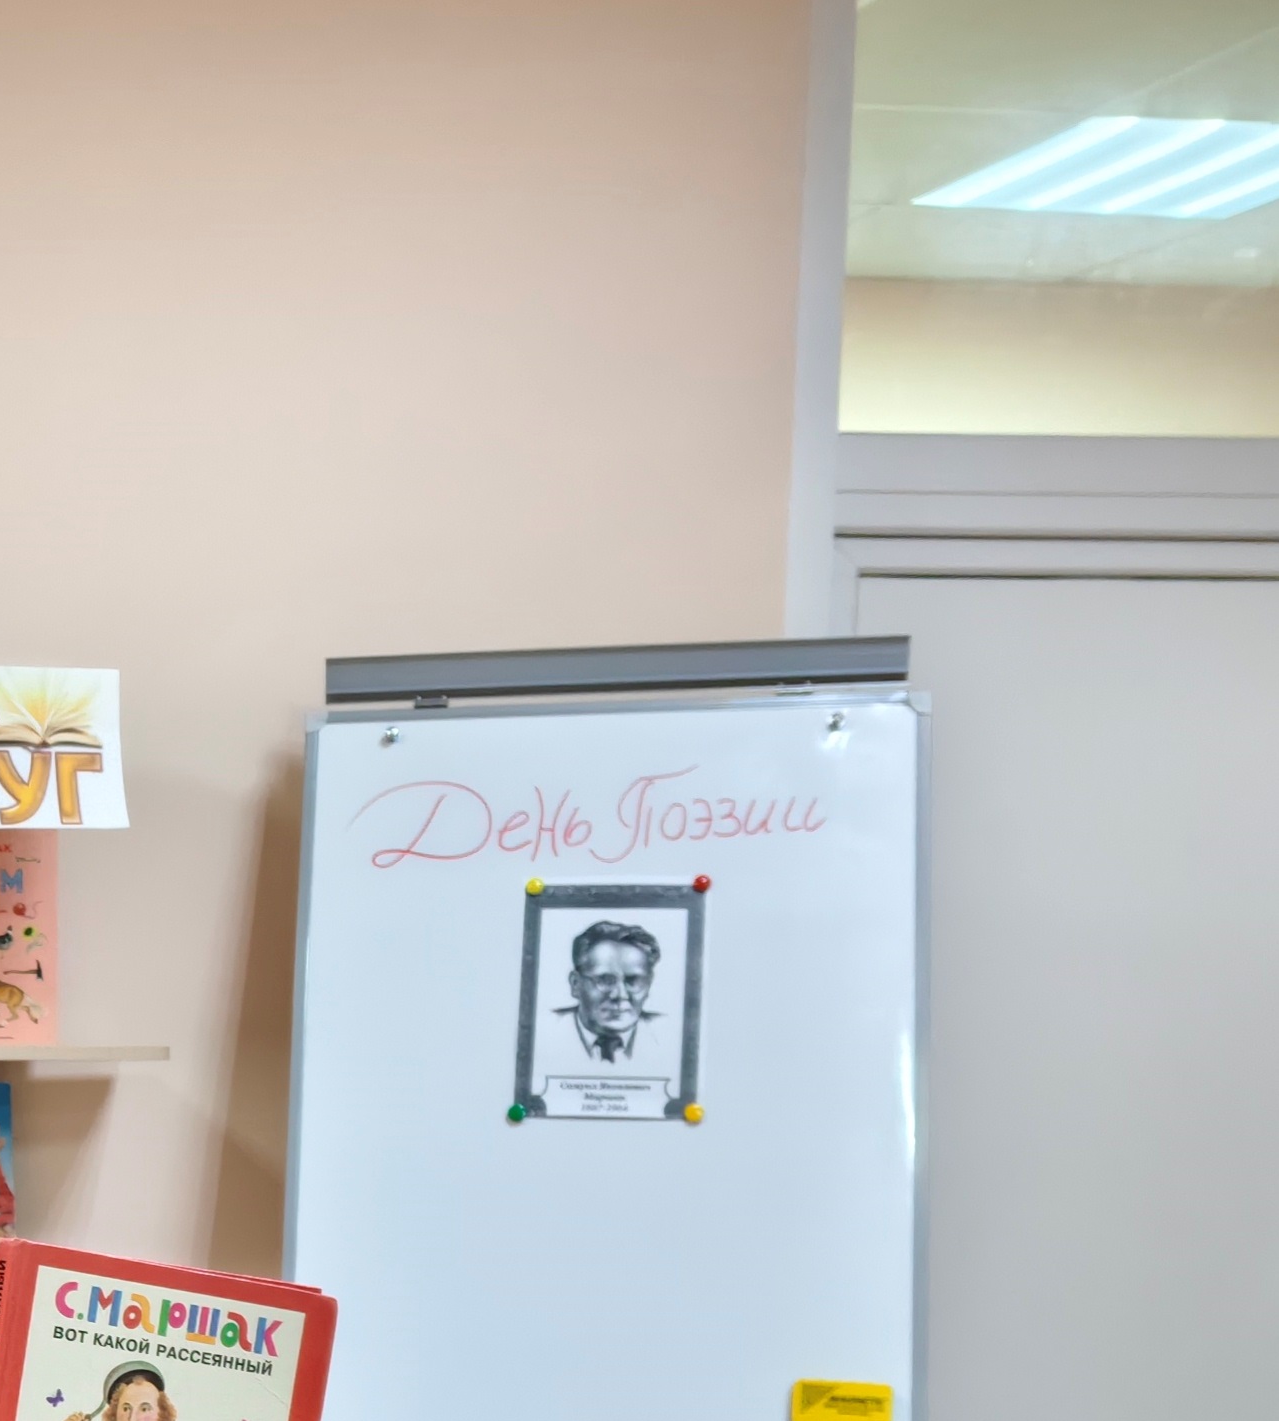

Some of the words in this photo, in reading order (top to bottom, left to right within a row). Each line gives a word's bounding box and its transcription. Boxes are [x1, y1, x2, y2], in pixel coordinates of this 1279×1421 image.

[345, 780, 592, 869] День
[589, 765, 827, 864] Поэзии
[52, 1325, 89, 1344] ВОТ
[93, 1332, 151, 1355] КАКОЙ
[155, 1345, 274, 1377] РАССЕЯННЫЙ
